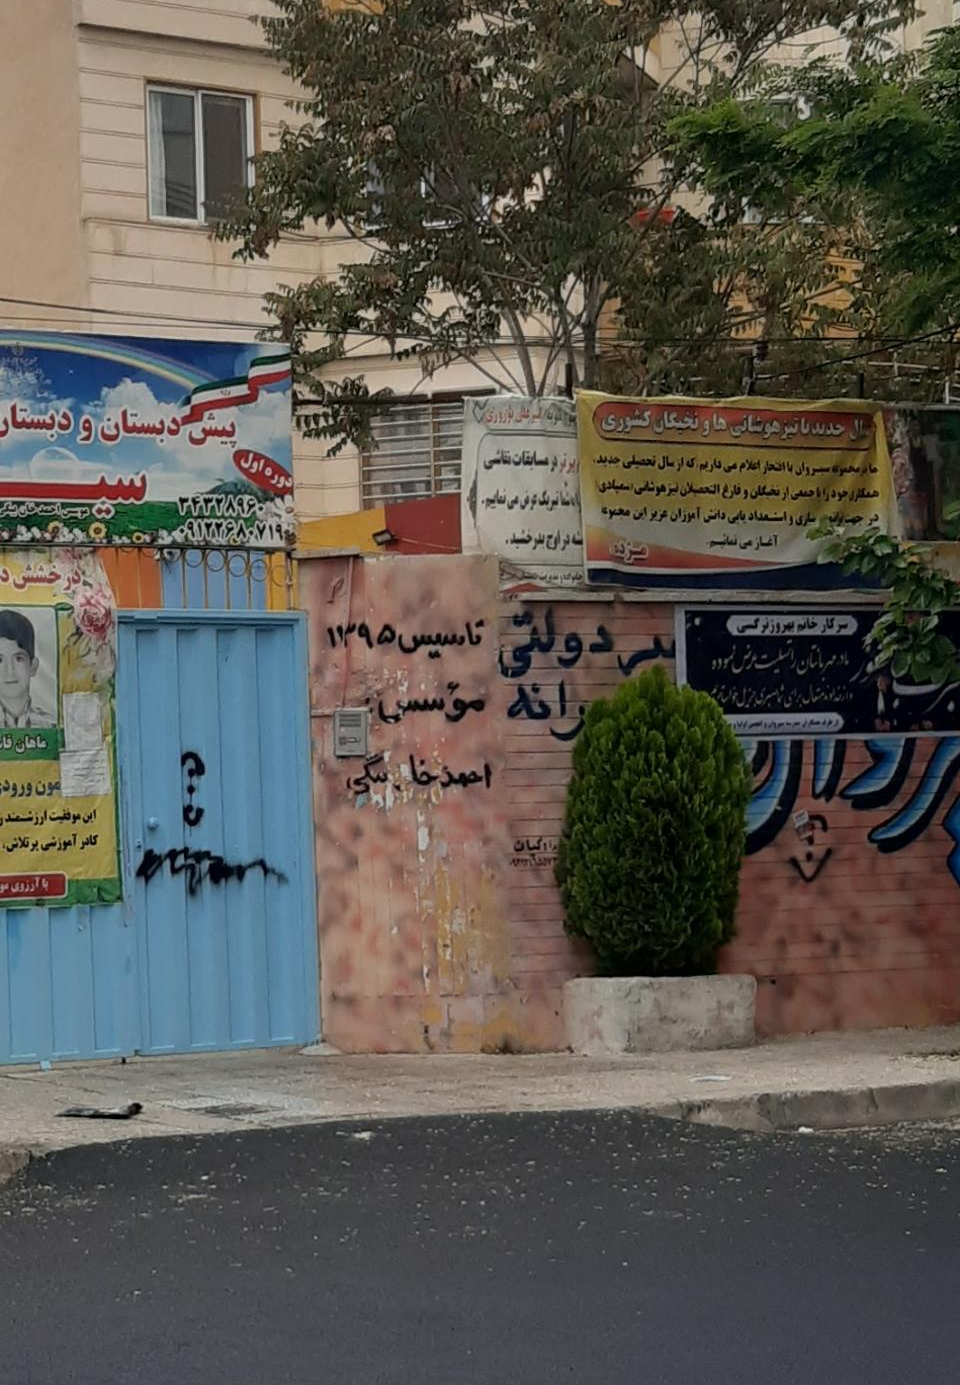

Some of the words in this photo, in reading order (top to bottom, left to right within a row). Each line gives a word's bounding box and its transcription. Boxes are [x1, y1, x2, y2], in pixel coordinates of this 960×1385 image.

[78, 416, 91, 441] و
[100, 408, 182, 443] دبستان
[600, 409, 652, 434] کشوری
[653, 410, 700, 435] نخبگان
[702, 417, 711, 437] و
[713, 413, 728, 432] ها
[188, 413, 238, 448] پیش
[239, 451, 266, 474] اول
[483, 450, 511, 471] نقاشی
[512, 451, 549, 471] مسابقات
[621, 454, 657, 471] تحصیلی
[657, 455, 676, 471] سال
[723, 462, 738, 474] می
[739, 458, 762, 474] اعلام
[264, 464, 294, 488] دوره
[795, 462, 831, 477] سیروان
[538, 489, 559, 512] تبریک
[721, 484, 742, 500] فارغ
[743, 487, 749, 500] و
[19, 501, 39, 517] خان
[39, 502, 61, 516] احمد
[507, 495, 520, 511] می
[600, 506, 631, 520] مجموعه
[632, 506, 648, 522] این
[648, 507, 668, 523] عزیز
[669, 506, 701, 524] آموزان
[703, 510, 727, 524] دانش
[747, 510, 787, 523] استعداد
[788, 514, 795, 526] و
[866, 512, 880, 526] در
[738, 538, 754, 551] می
[754, 533, 780, 551] آغاز
[13, 564, 83, 593] درخشش
[796, 616, 819, 634] خانم
[326, 622, 397, 650] ۱۳۹۵
[498, 604, 614, 679] دولتی
[15, 738, 49, 755] ماهان
[5, 810, 48, 826] ارزشمند
[49, 809, 81, 825] موفقیت
[82, 808, 97, 825] این
[41, 832, 78, 851] آموزشی
[79, 833, 99, 850] کادر
[10, 877, 40, 894] آرزوی
[41, 880, 49, 893] با
